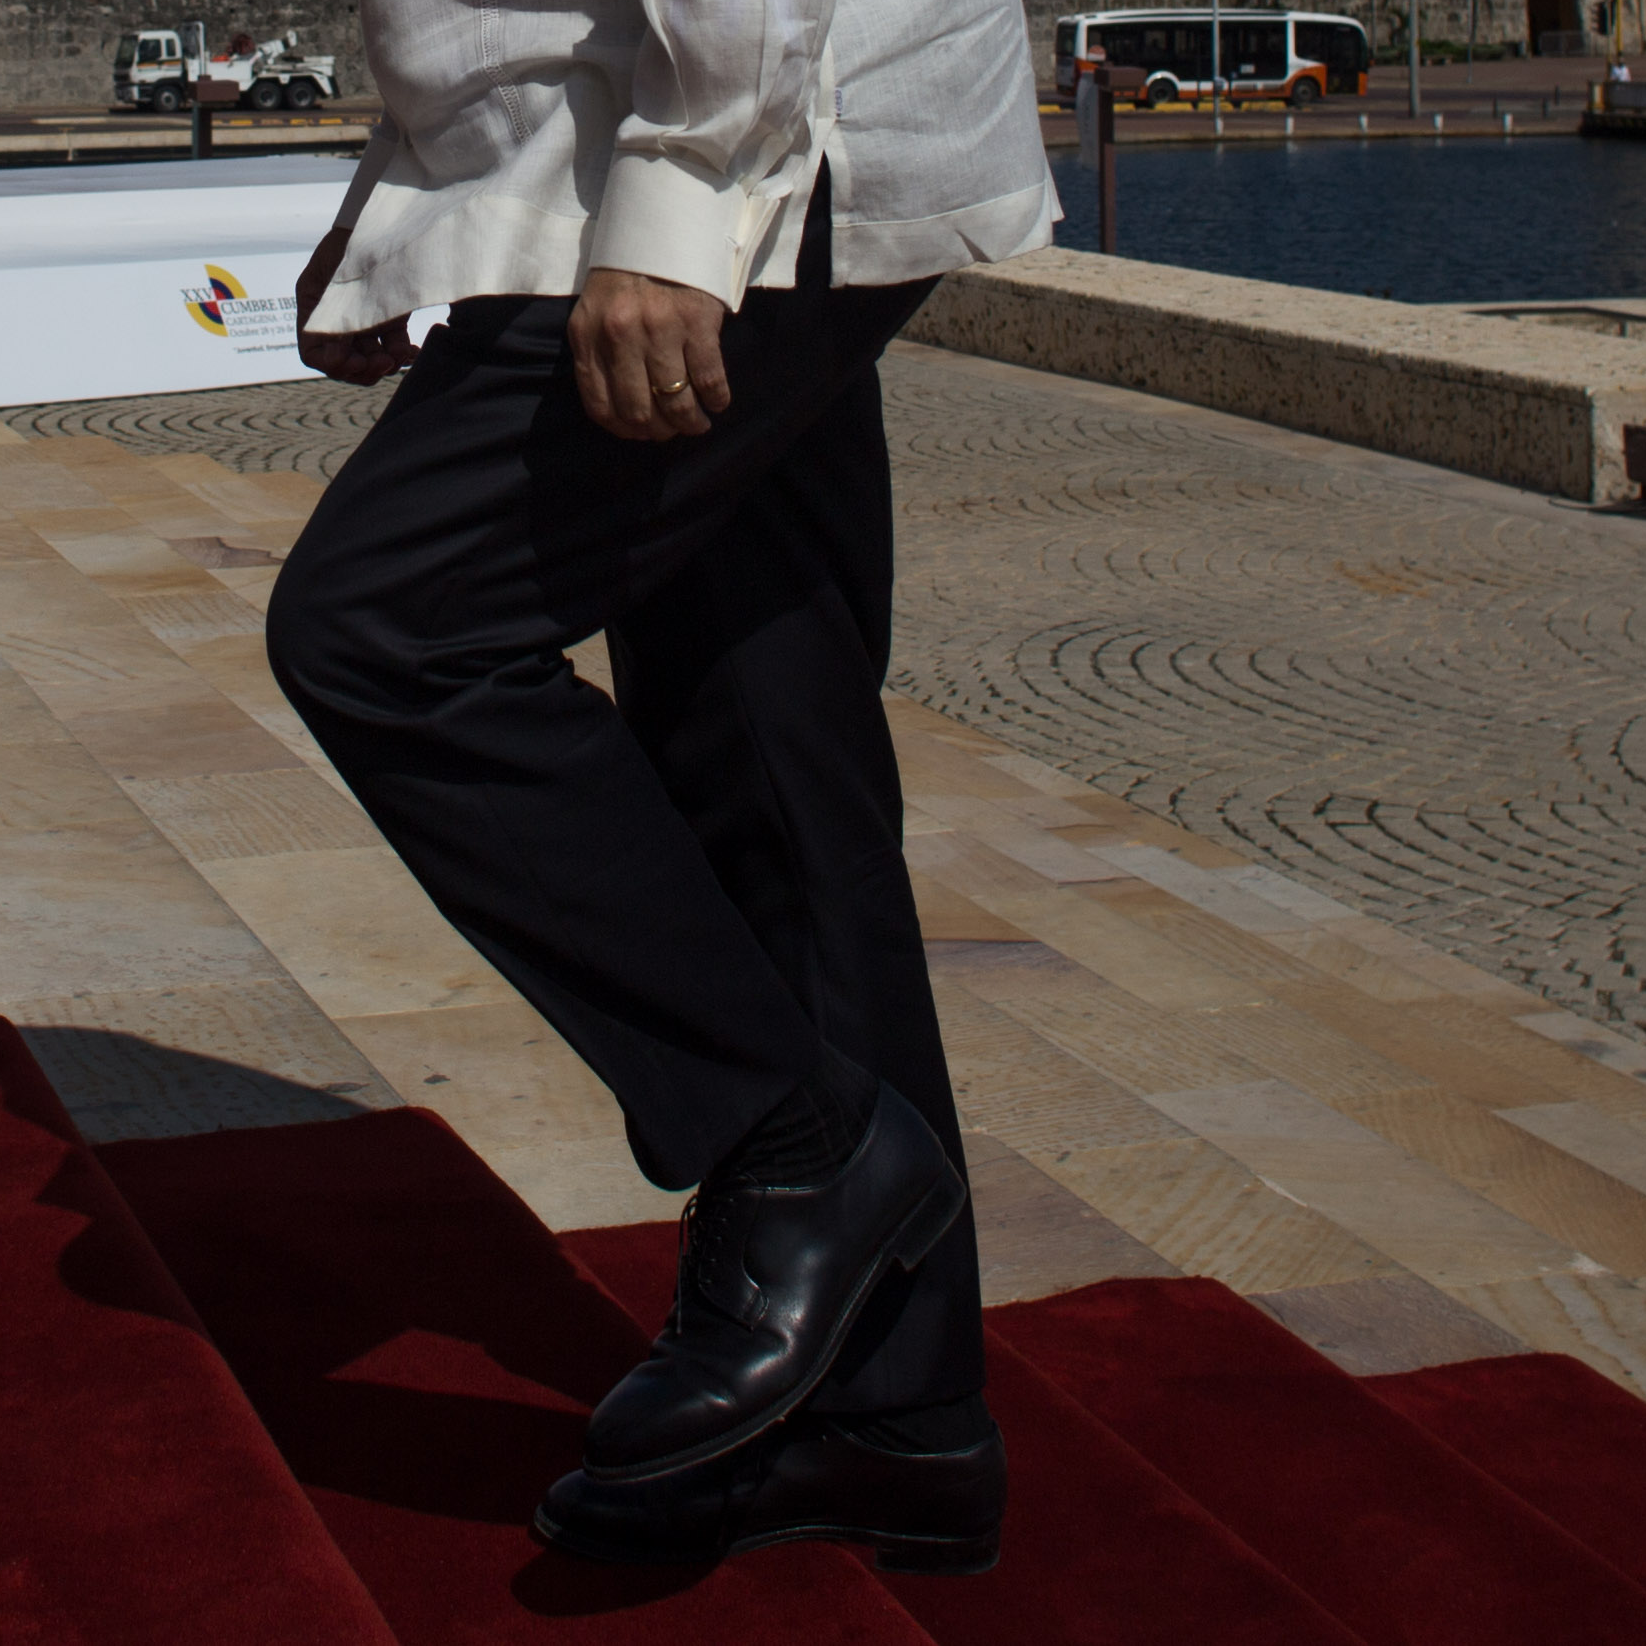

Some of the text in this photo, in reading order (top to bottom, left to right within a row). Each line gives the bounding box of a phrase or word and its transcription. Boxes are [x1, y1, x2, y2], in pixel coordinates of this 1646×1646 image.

[180, 286, 213, 302] XXV
[220, 298, 277, 314] CUMBRE
[226, 314, 278, 327] CARTAGENA
[229, 328, 259, 338] Octubre
